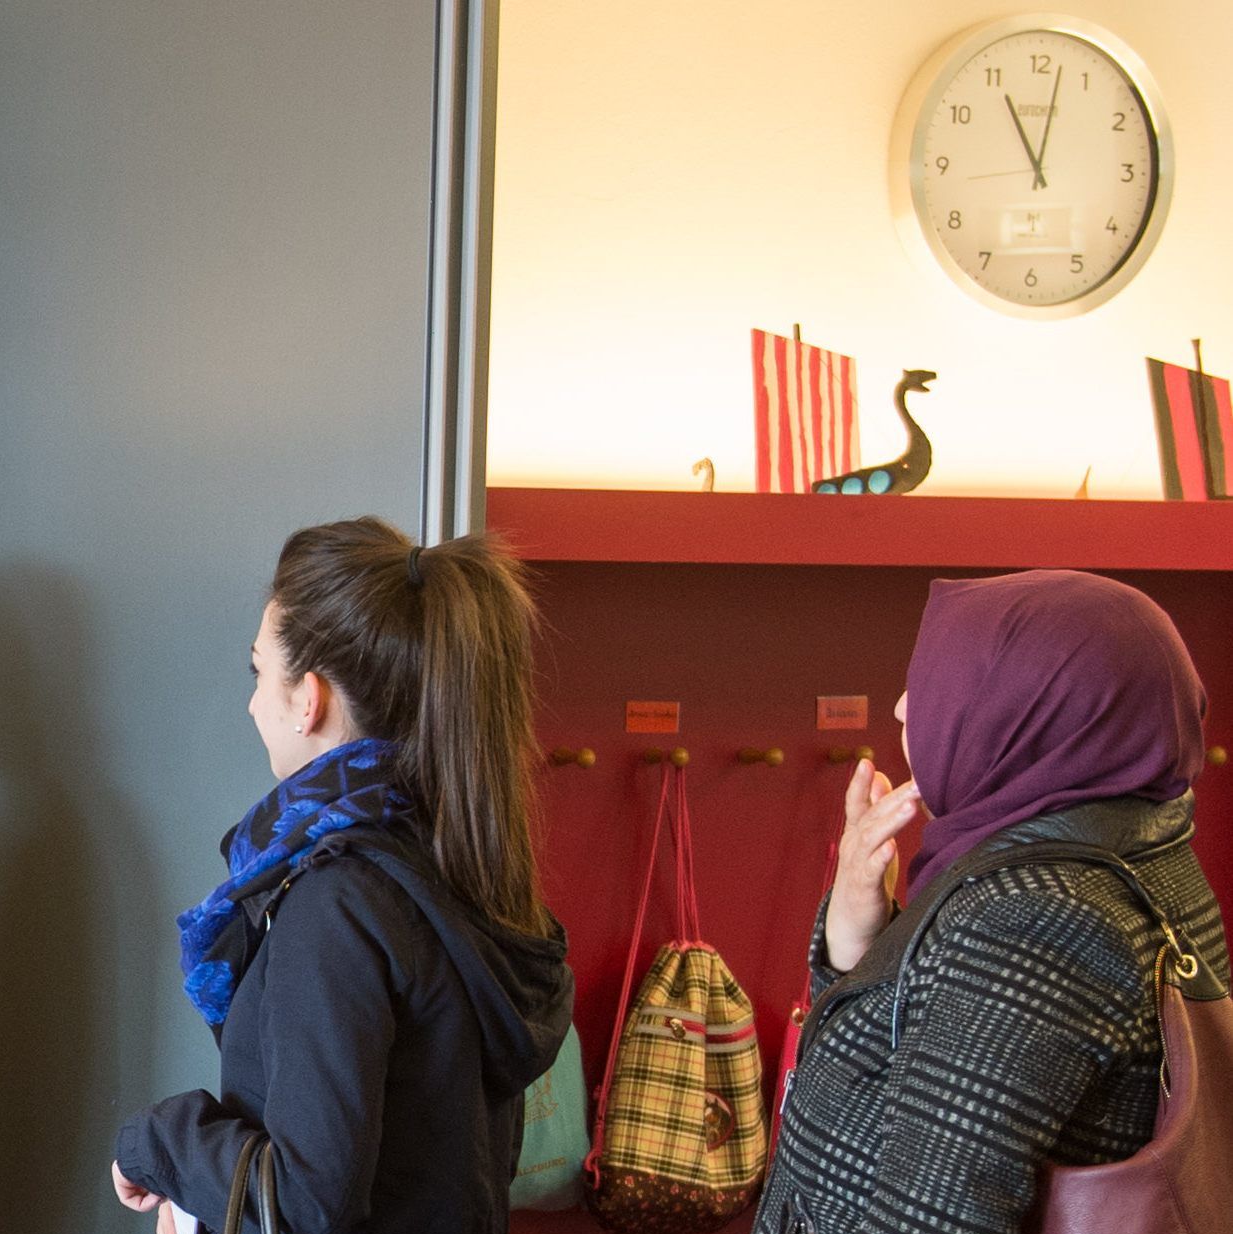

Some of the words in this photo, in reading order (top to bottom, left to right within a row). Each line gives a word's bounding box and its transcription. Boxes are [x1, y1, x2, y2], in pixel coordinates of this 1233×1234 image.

[1029, 55, 1051, 74] 12
[985, 68, 1001, 87] 11
[1081, 72, 1088, 91] 1
[950, 105, 971, 124] 10
[1111, 112, 1126, 132] 2
[936, 156, 950, 176] 9
[1120, 163, 1134, 183] 3
[948, 210, 962, 230] 8
[1105, 216, 1118, 235] 4
[978, 251, 992, 271] 7
[1069, 254, 1083, 273] 5
[1024, 268, 1038, 287] 6
[516, 1156, 566, 1177] ALZBURG
